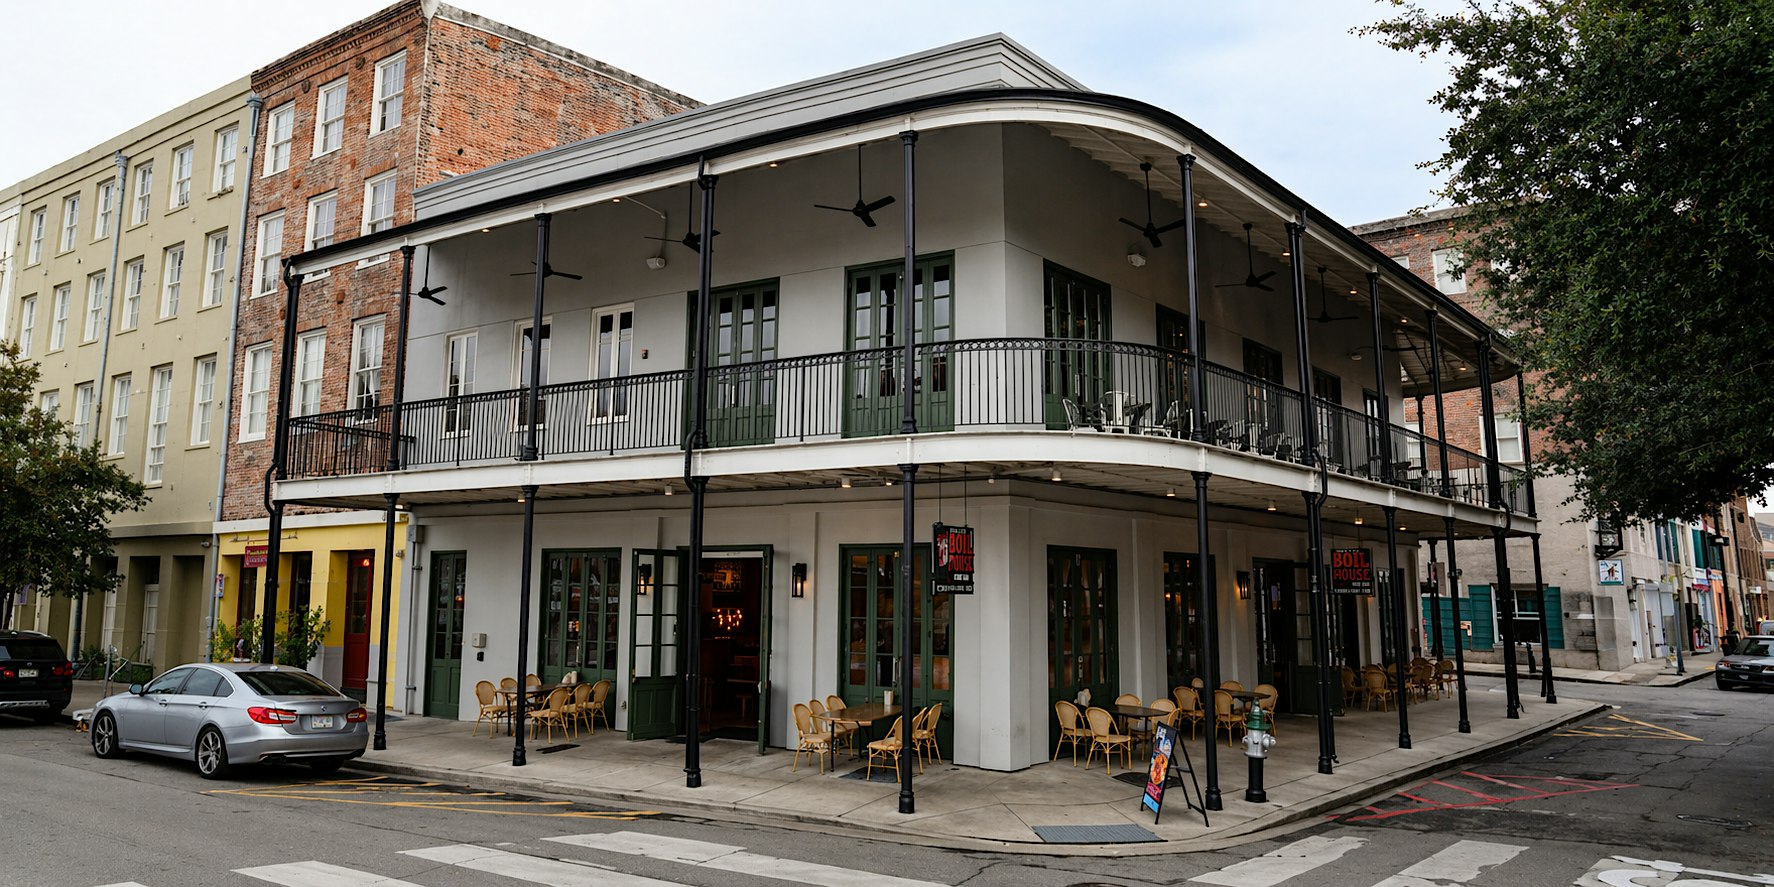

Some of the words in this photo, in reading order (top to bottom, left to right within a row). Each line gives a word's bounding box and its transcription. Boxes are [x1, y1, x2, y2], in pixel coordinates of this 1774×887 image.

[949, 533, 973, 554] BOIL
[1333, 552, 1369, 567] BOIL
[1333, 569, 1370, 580] HOUSE
